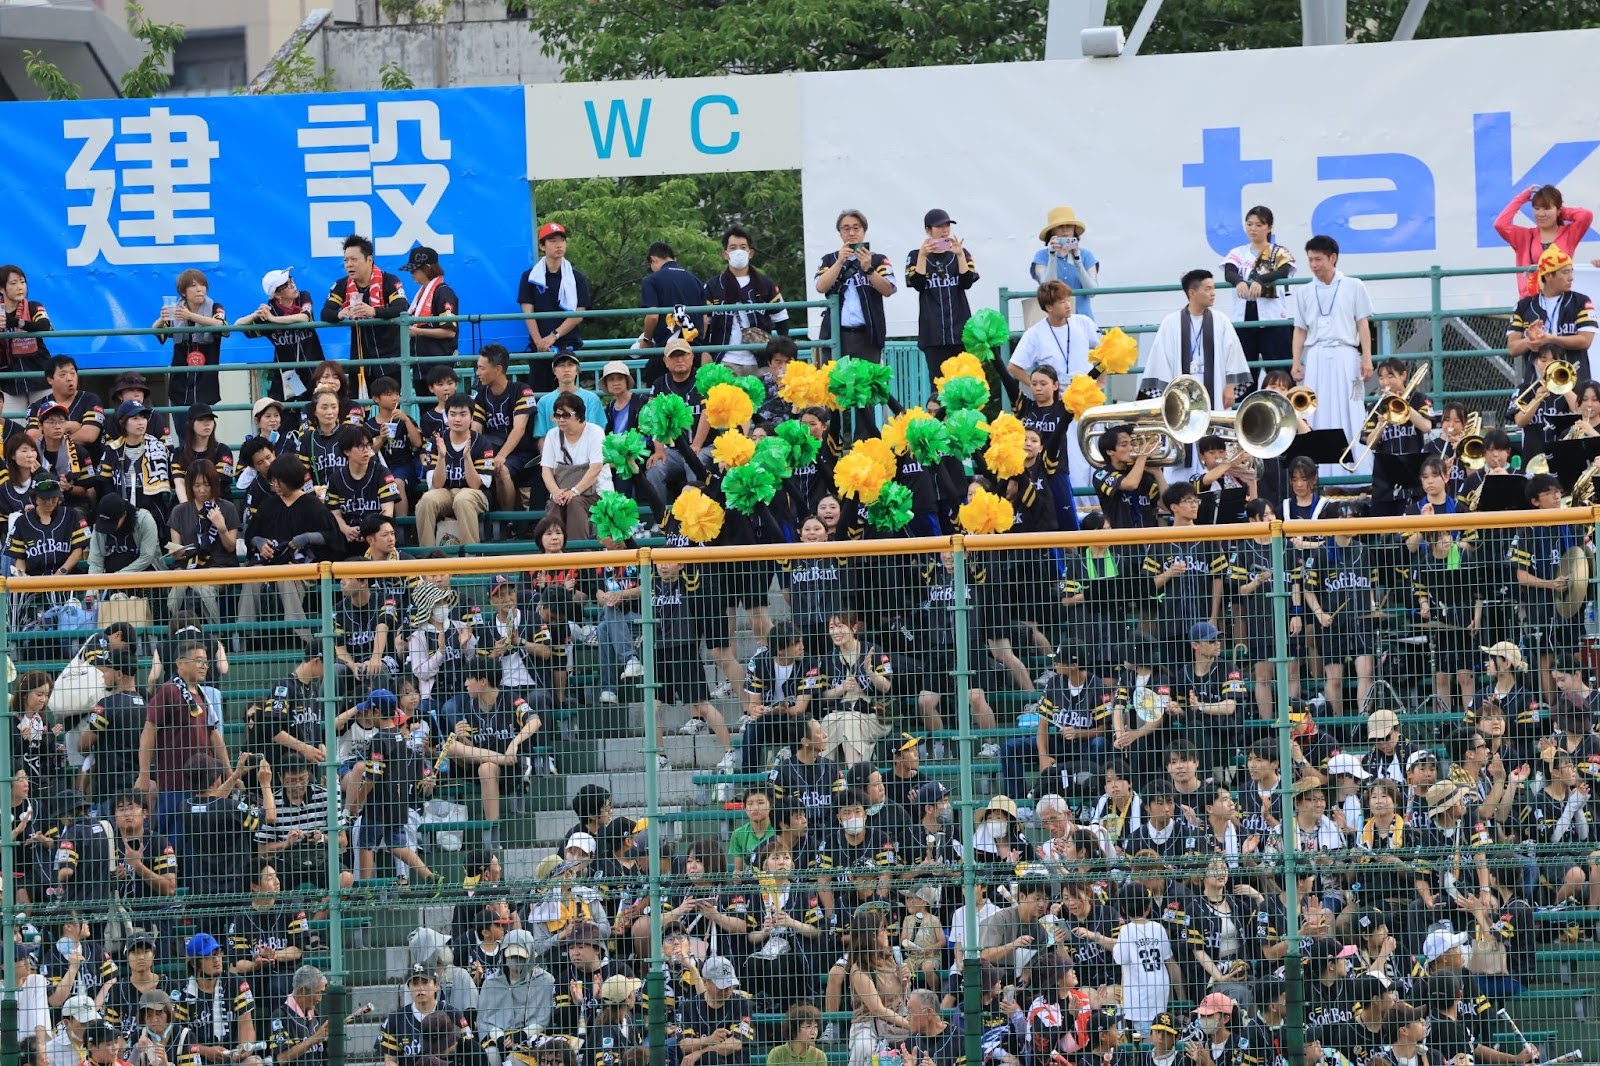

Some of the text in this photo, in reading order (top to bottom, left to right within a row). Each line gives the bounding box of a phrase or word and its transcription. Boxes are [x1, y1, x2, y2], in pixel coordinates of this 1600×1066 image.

[64, 100, 454, 267] 建設
[1324, 572, 1372, 594] SoftBan
[1308, 1007, 1353, 1029] SoftBan
